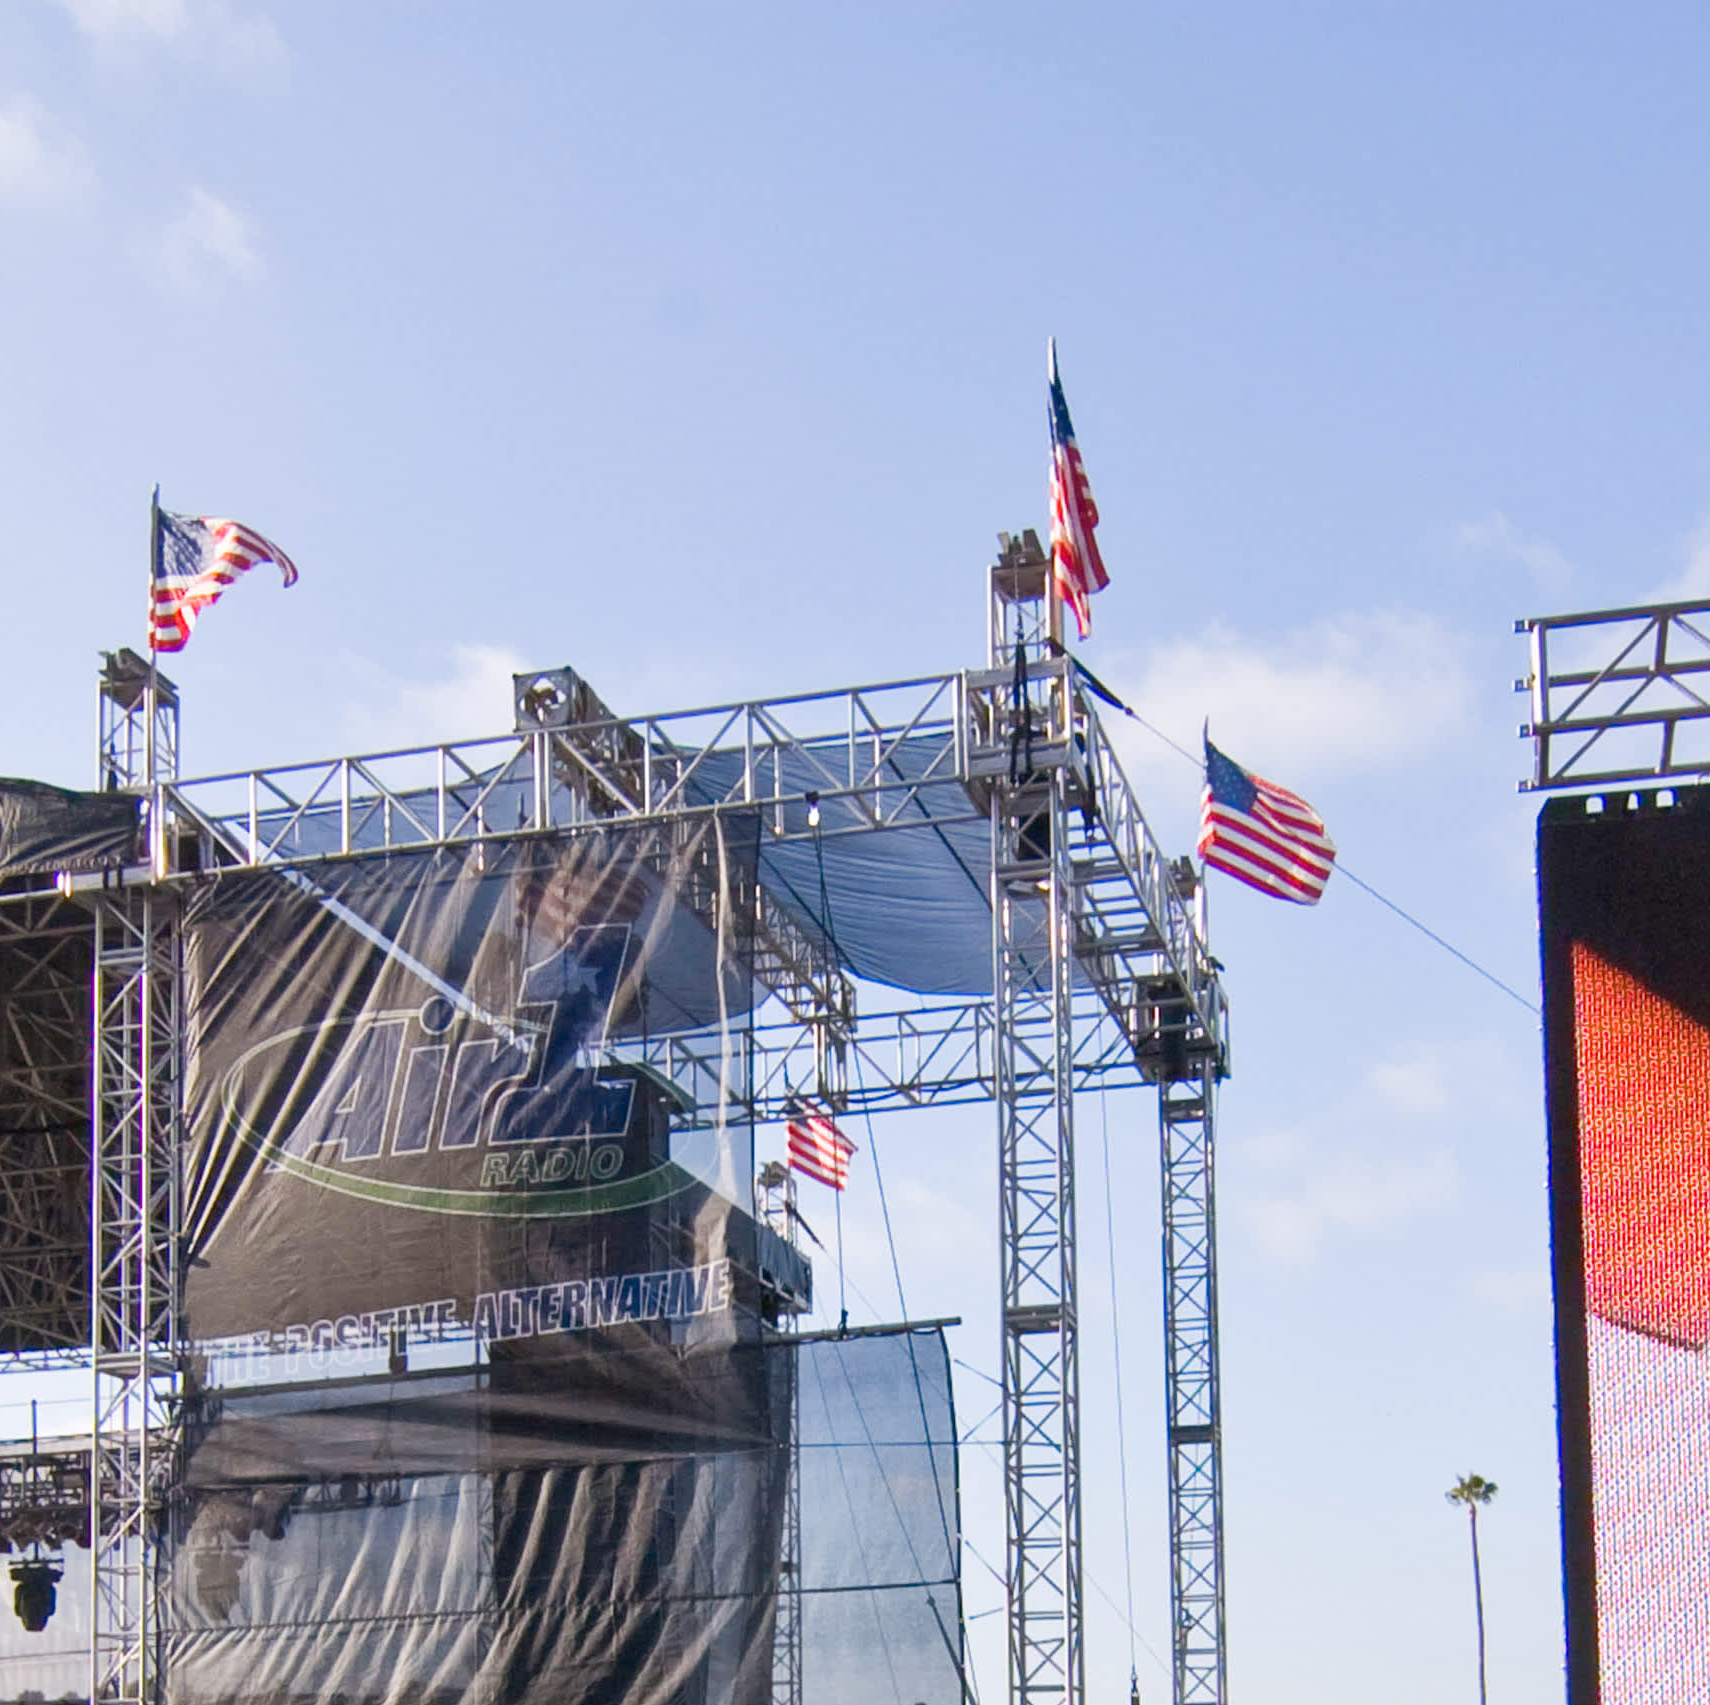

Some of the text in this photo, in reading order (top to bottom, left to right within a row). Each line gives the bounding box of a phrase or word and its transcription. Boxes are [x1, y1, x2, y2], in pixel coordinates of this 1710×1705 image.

[479, 1143, 625, 1188] RADIO
[284, 1298, 458, 1374] POSITIVE
[472, 1256, 731, 1344] ALTERNATIVE
